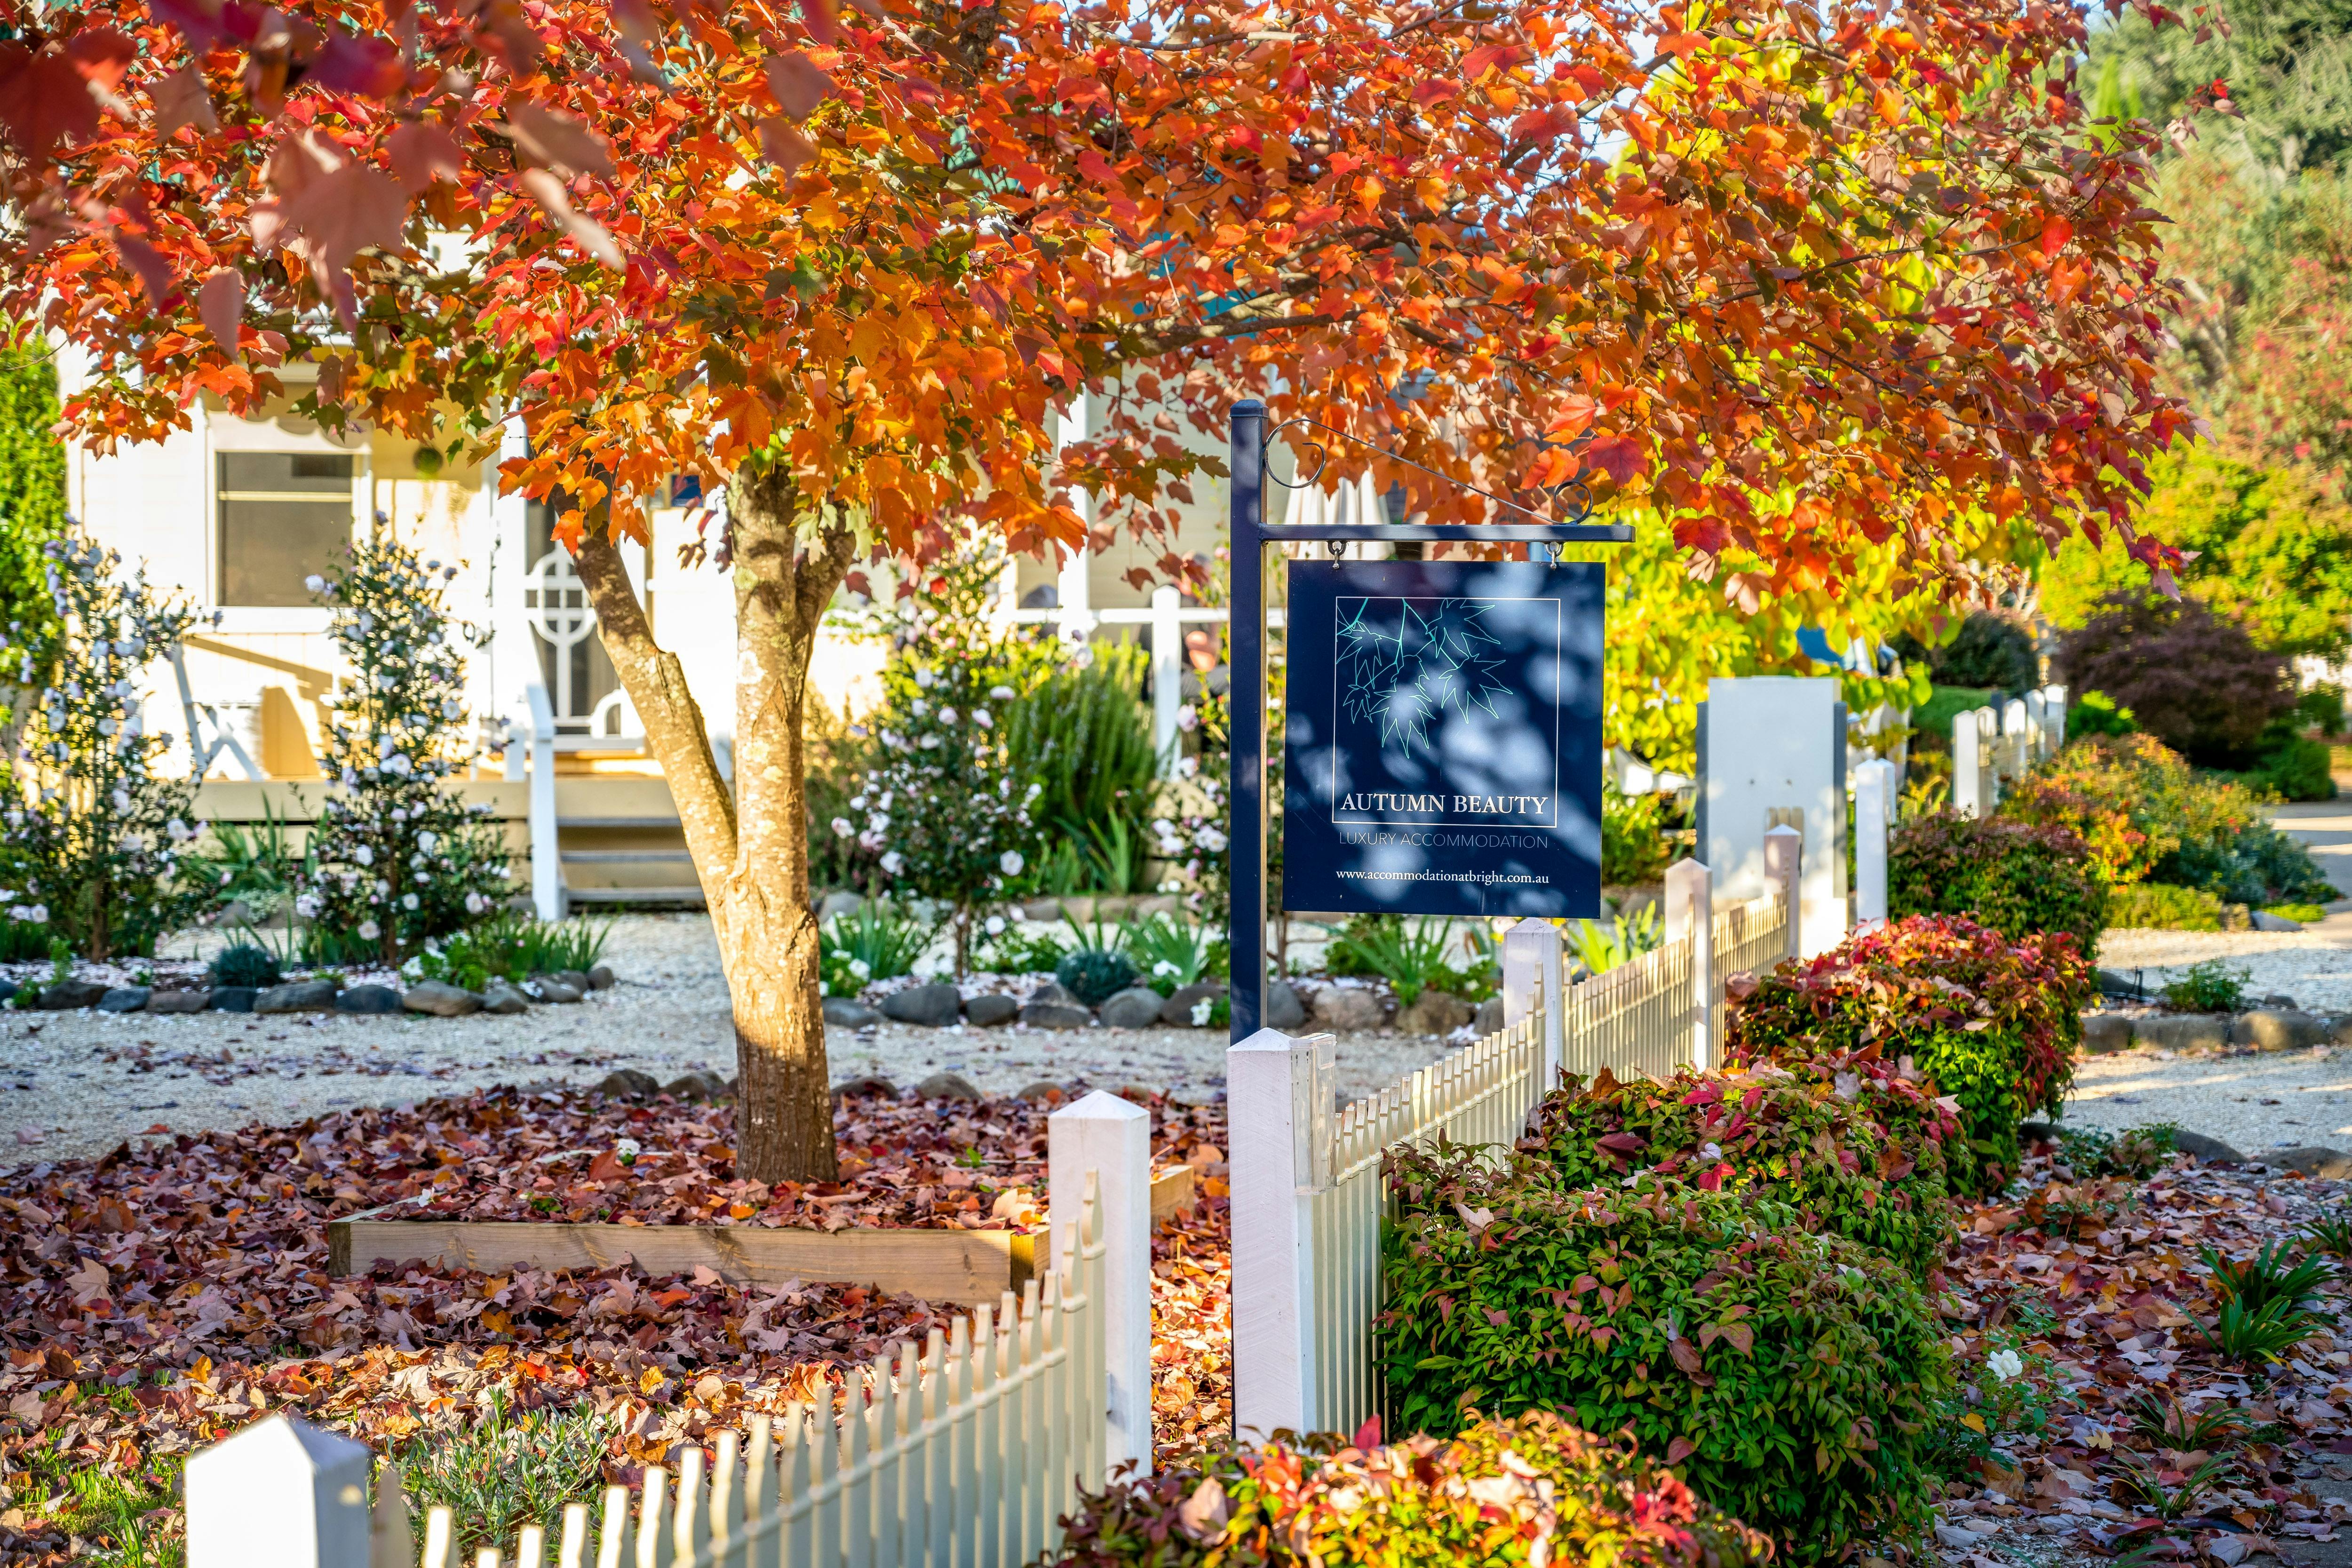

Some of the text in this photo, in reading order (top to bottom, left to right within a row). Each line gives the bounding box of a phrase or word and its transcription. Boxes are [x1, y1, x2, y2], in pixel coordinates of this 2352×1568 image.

[1340, 793, 1549, 814] AUTUMN BEAUTY
[1339, 832, 1548, 849] LUXURY ACCOMMODATION
[1336, 869, 1549, 885] www.accommodationatbright.com.au
